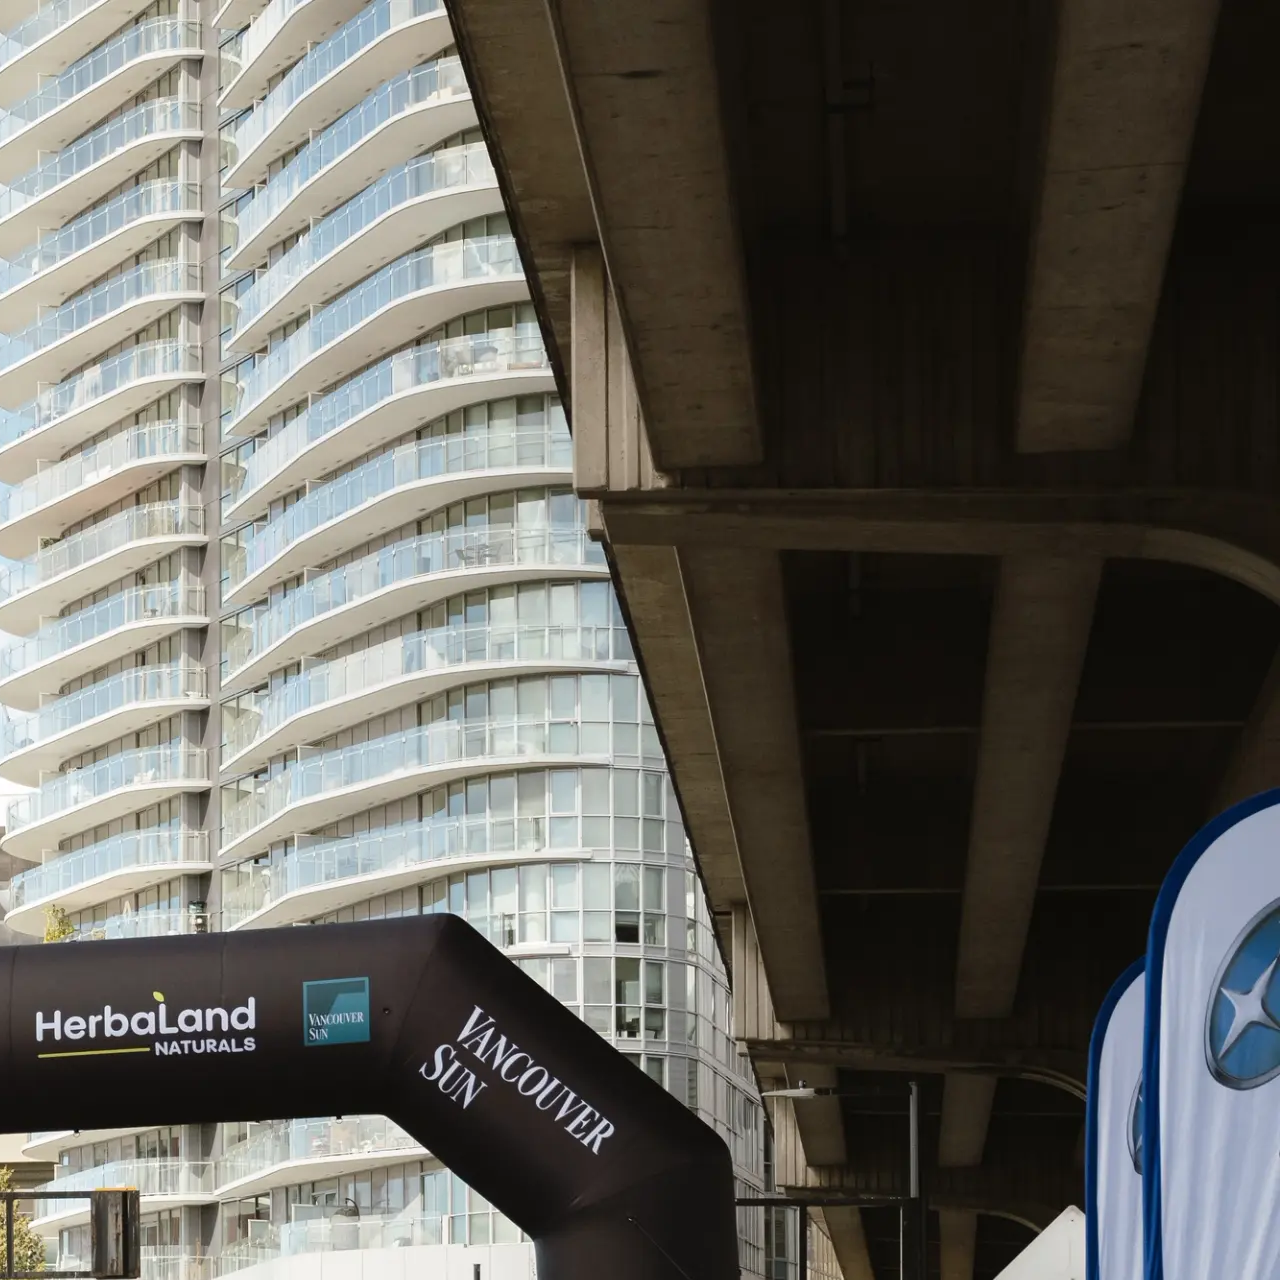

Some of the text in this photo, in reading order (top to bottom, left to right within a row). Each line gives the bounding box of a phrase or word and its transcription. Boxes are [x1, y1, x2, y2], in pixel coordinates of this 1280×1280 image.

[308, 1011, 364, 1026] VANCOUVER
[308, 1026, 328, 1041] SUN
[154, 1036, 256, 1056] NATURALS
[418, 1044, 489, 1110] SUN
[456, 1004, 615, 1155] VANCOUVER
